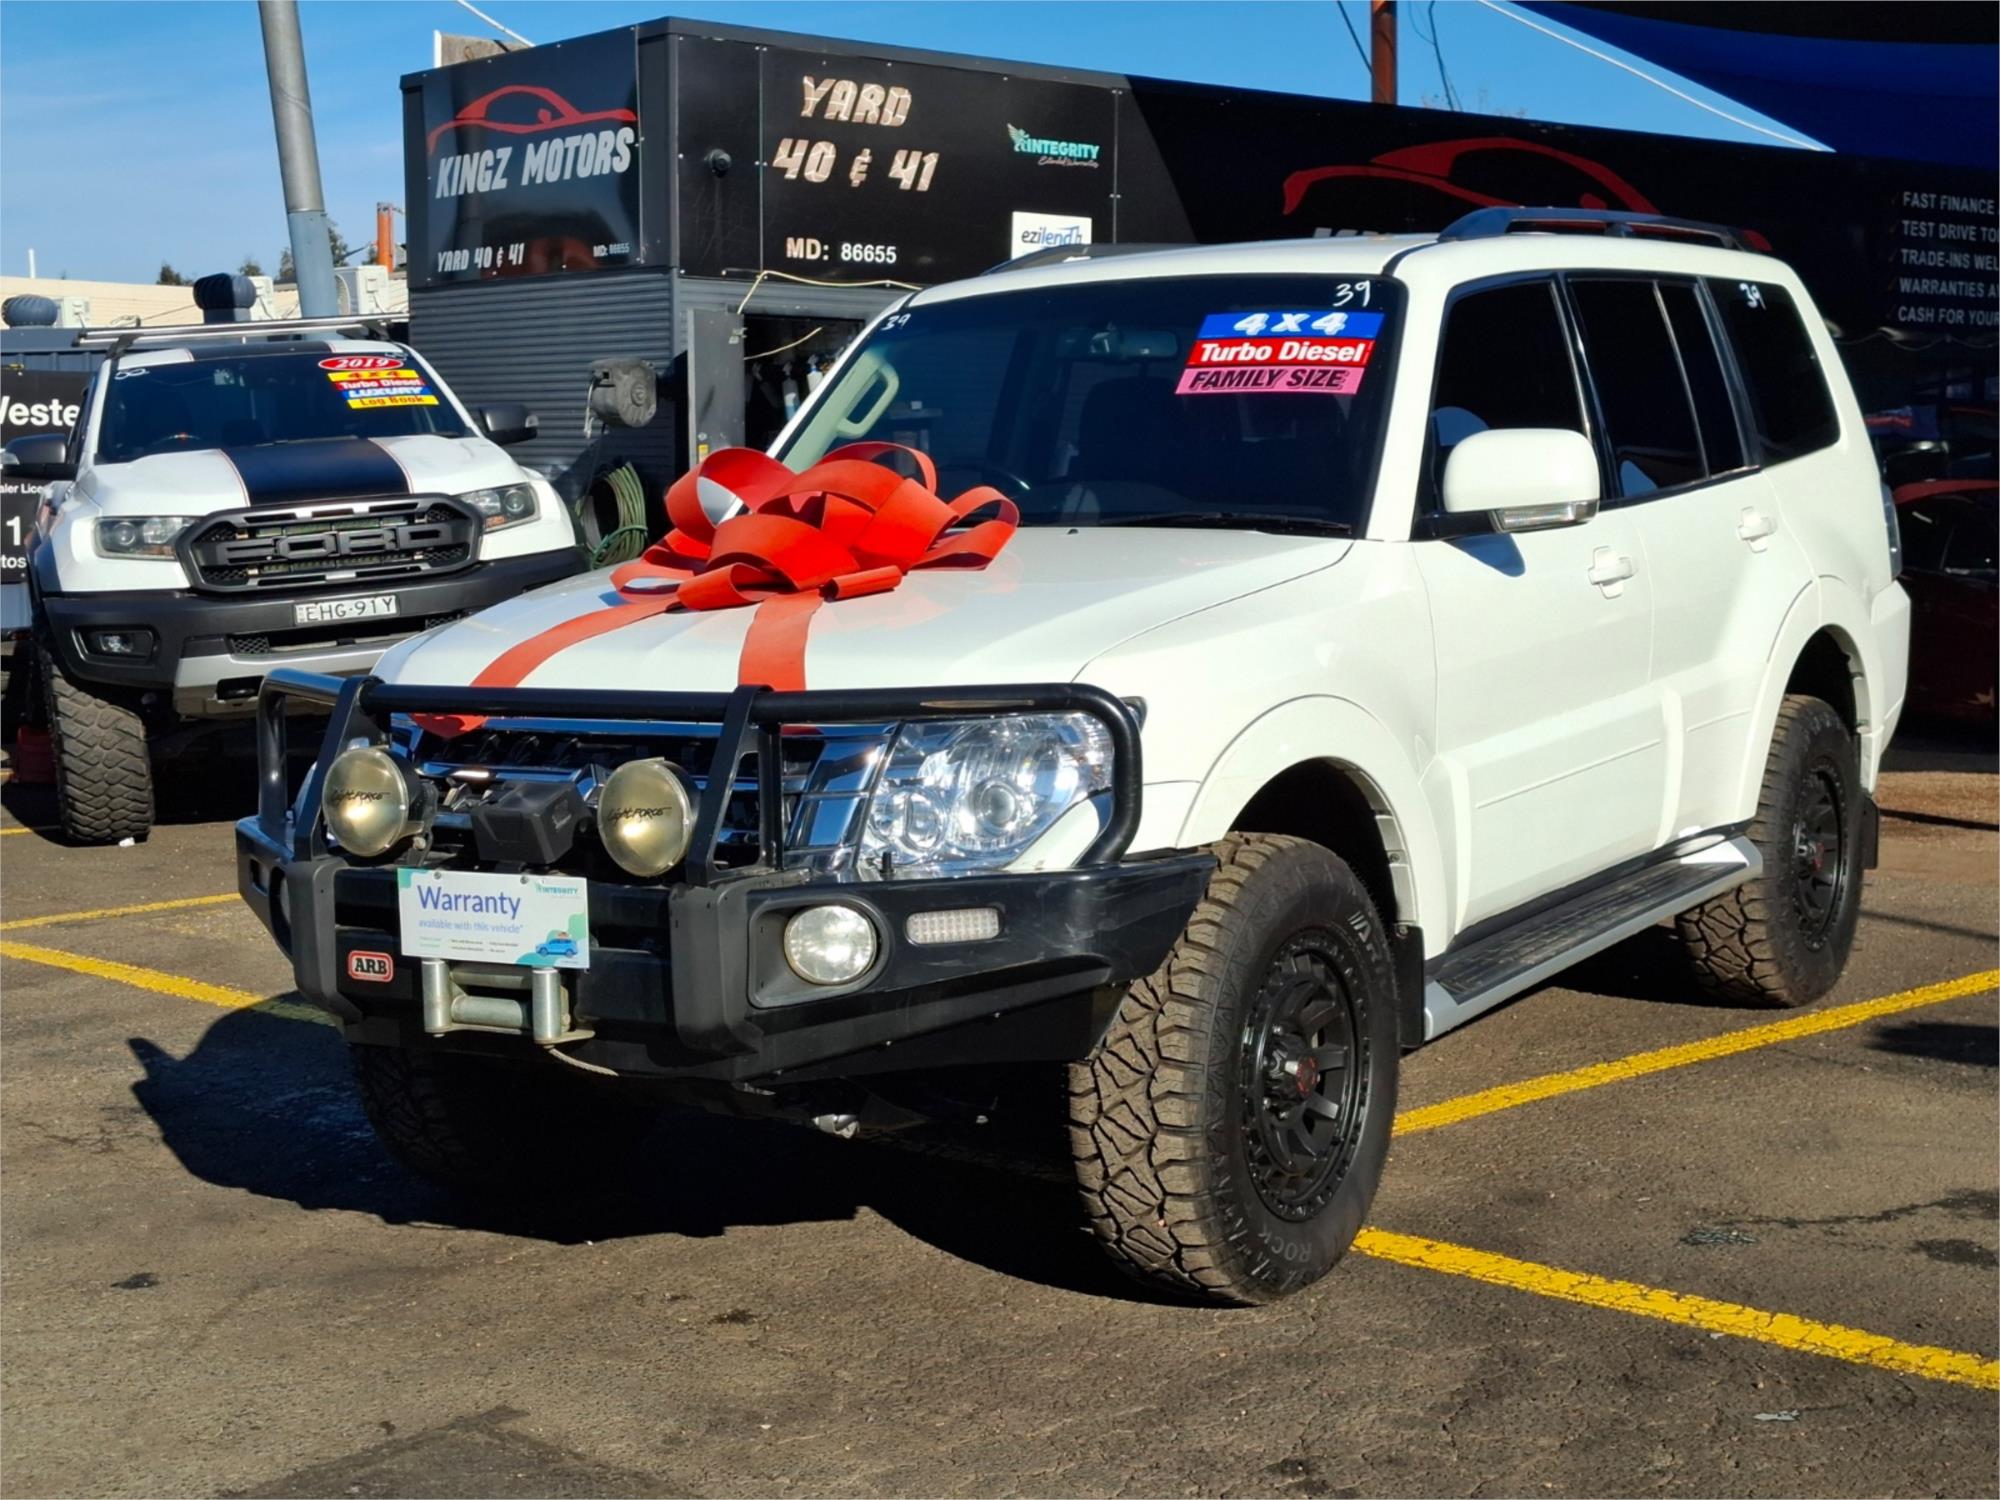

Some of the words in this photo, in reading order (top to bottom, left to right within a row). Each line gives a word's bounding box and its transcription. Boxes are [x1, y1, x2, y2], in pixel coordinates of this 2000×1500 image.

[801, 76, 912, 127] YARD
[1024, 137, 1100, 159] INTEGRITY
[436, 147, 512, 198] KINGZ
[521, 127, 634, 186] MOTORS
[773, 138, 836, 183] 40
[889, 150, 939, 191] 41
[1903, 191, 1937, 209] FAST
[1940, 195, 1995, 215] FINANCE
[1902, 220, 1935, 238] TEST
[1939, 223, 1977, 241] DRIVE
[437, 250, 468, 272] YARD
[474, 247, 493, 268] 40
[508, 243, 525, 265] 41
[786, 237, 829, 260] MD:
[841, 243, 896, 264] 86655
[1900, 248, 1971, 269] TRADE-INS
[1333, 280, 1370, 307] 39
[1899, 277, 1984, 298] WARRANTIES
[1898, 306, 1935, 323] CASH
[1938, 308, 1965, 325] FOR
[1201, 342, 1272, 363] Turbo
[1278, 341, 1365, 362] Diesel
[335, 358, 389, 369] 2019
[341, 381, 379, 389] Turbo
[1189, 369, 1284, 390] FAMILY
[1286, 368, 1347, 391] SIZE
[360, 397, 386, 407] Log
[389, 396, 425, 405] Book
[6, 516, 21, 546] 1
[417, 884, 520, 920] Warranty
[355, 957, 388, 975] ARB
